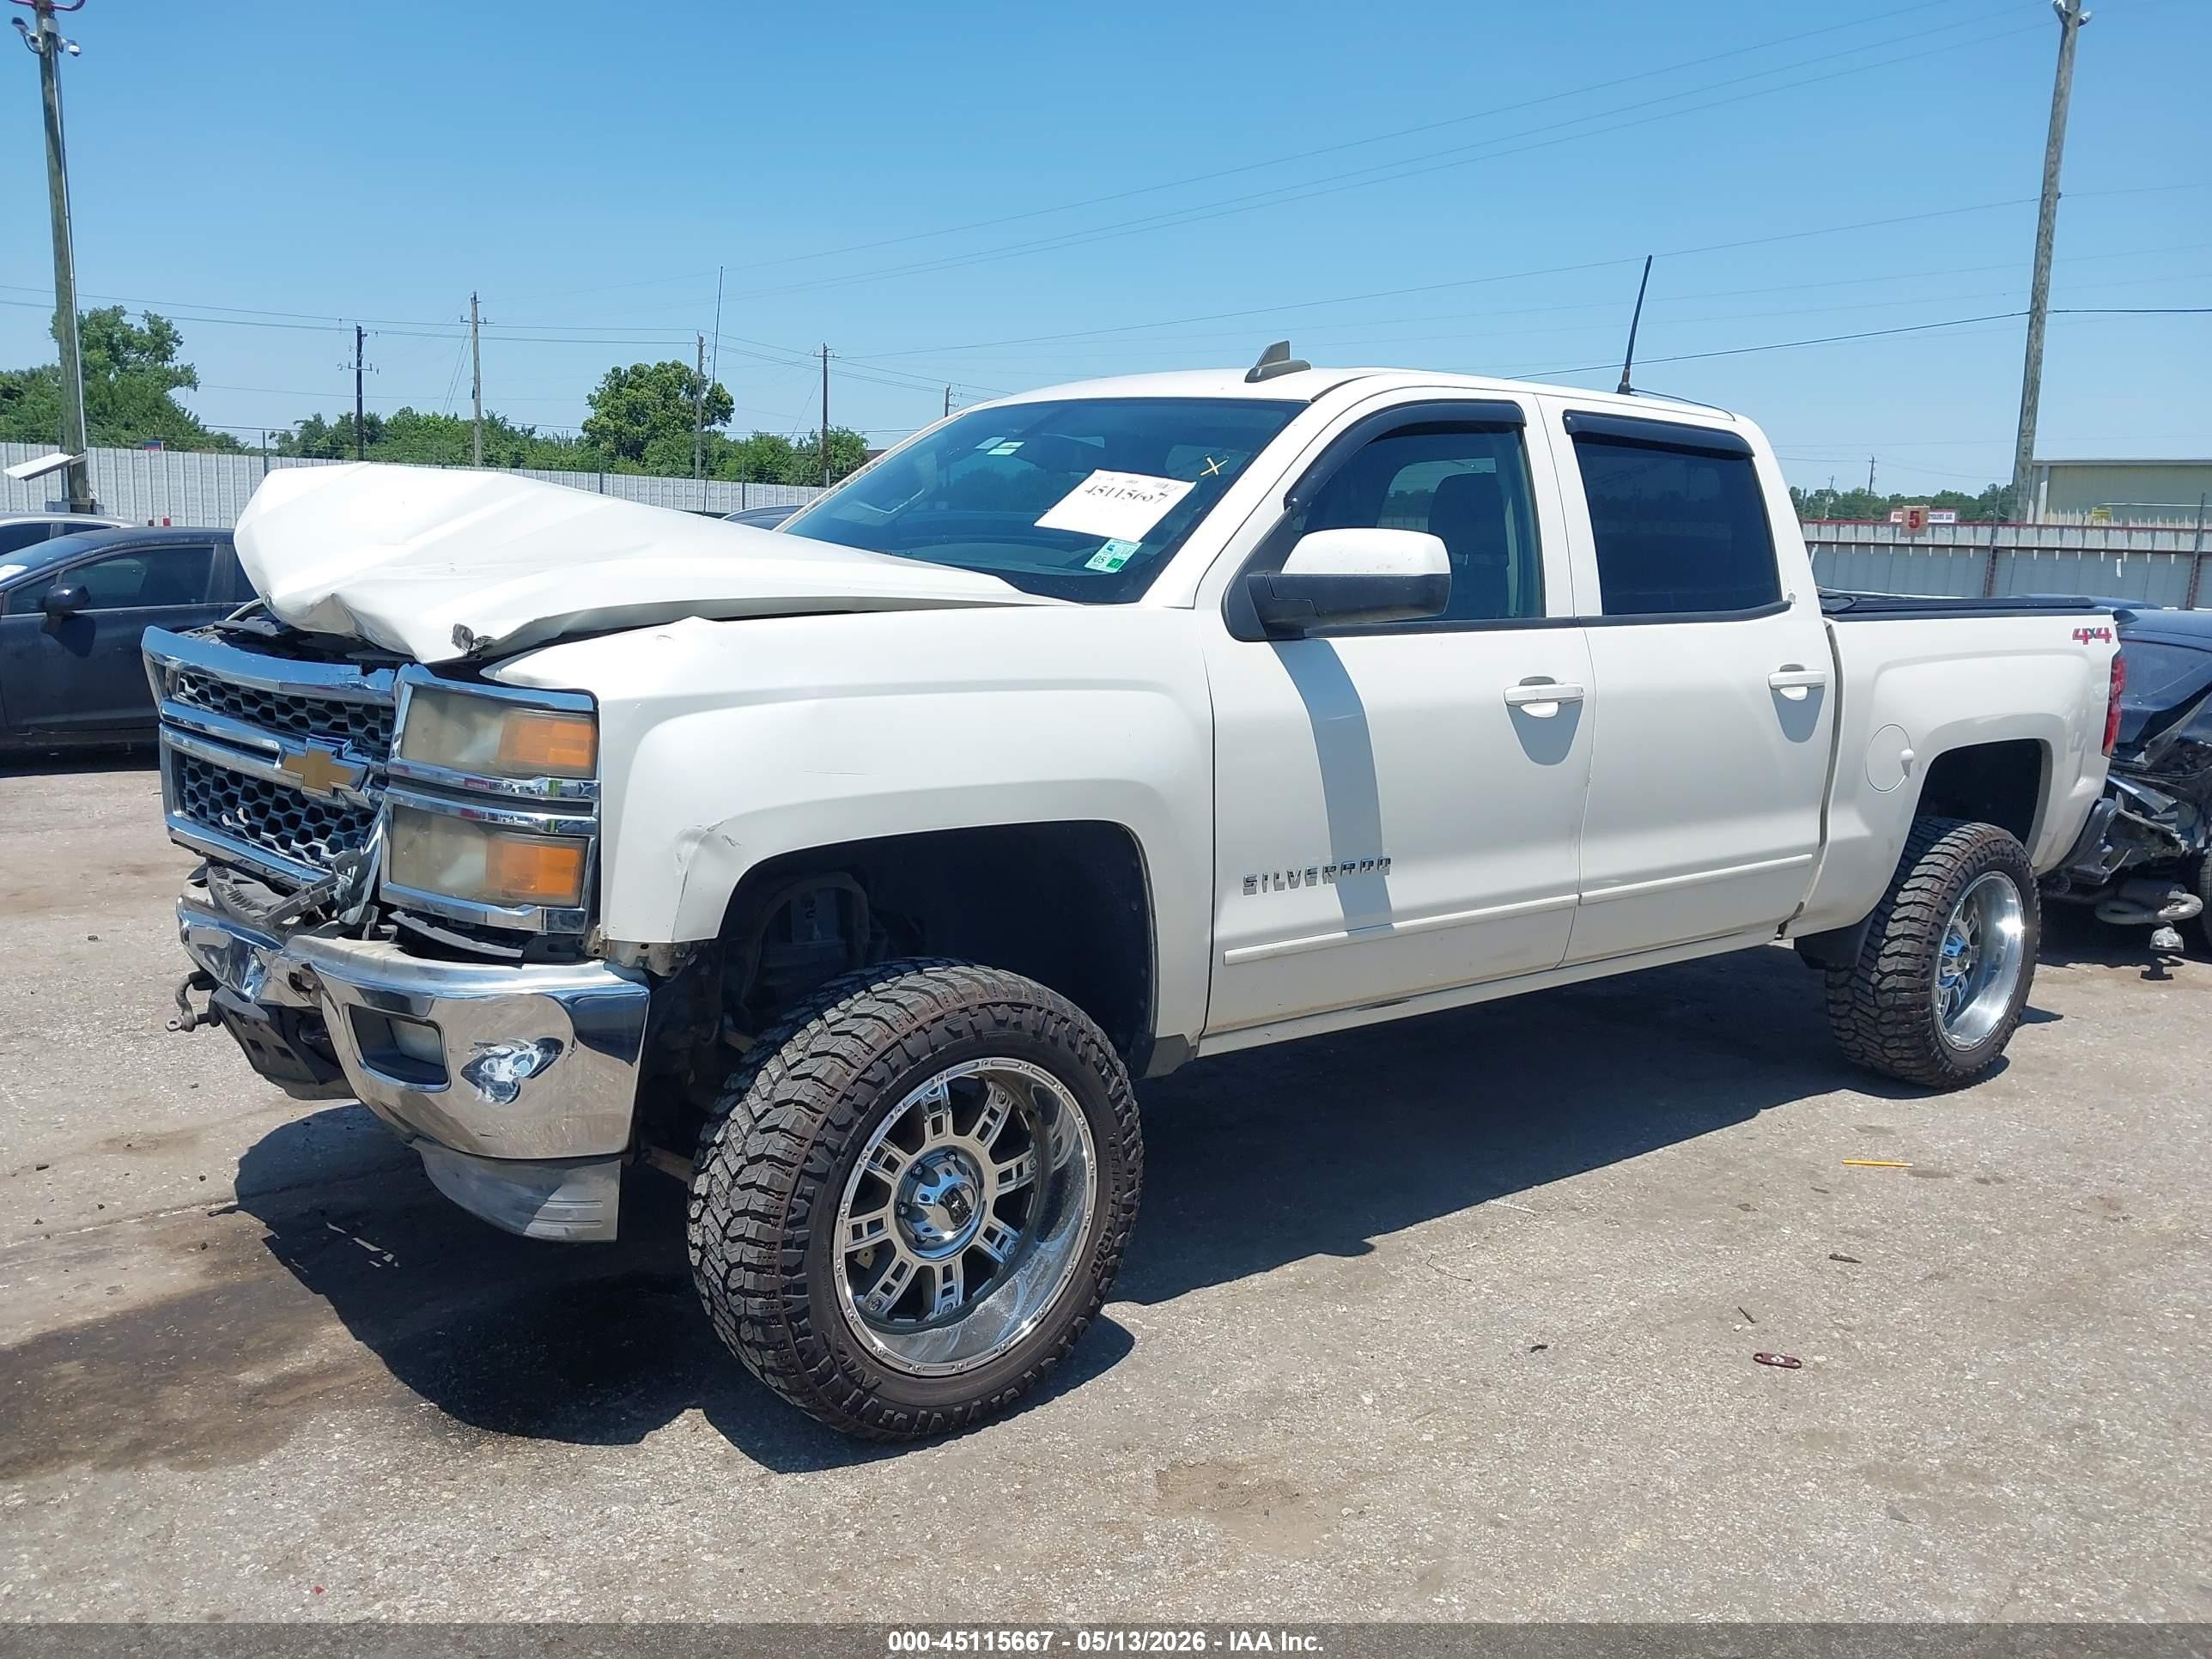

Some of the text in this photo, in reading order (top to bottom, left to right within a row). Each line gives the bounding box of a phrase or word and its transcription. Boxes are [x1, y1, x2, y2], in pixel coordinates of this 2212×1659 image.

[1908, 510, 1920, 529] 5
[1093, 555, 1107, 564] 05
[1243, 855, 1392, 896] SILVERADO
